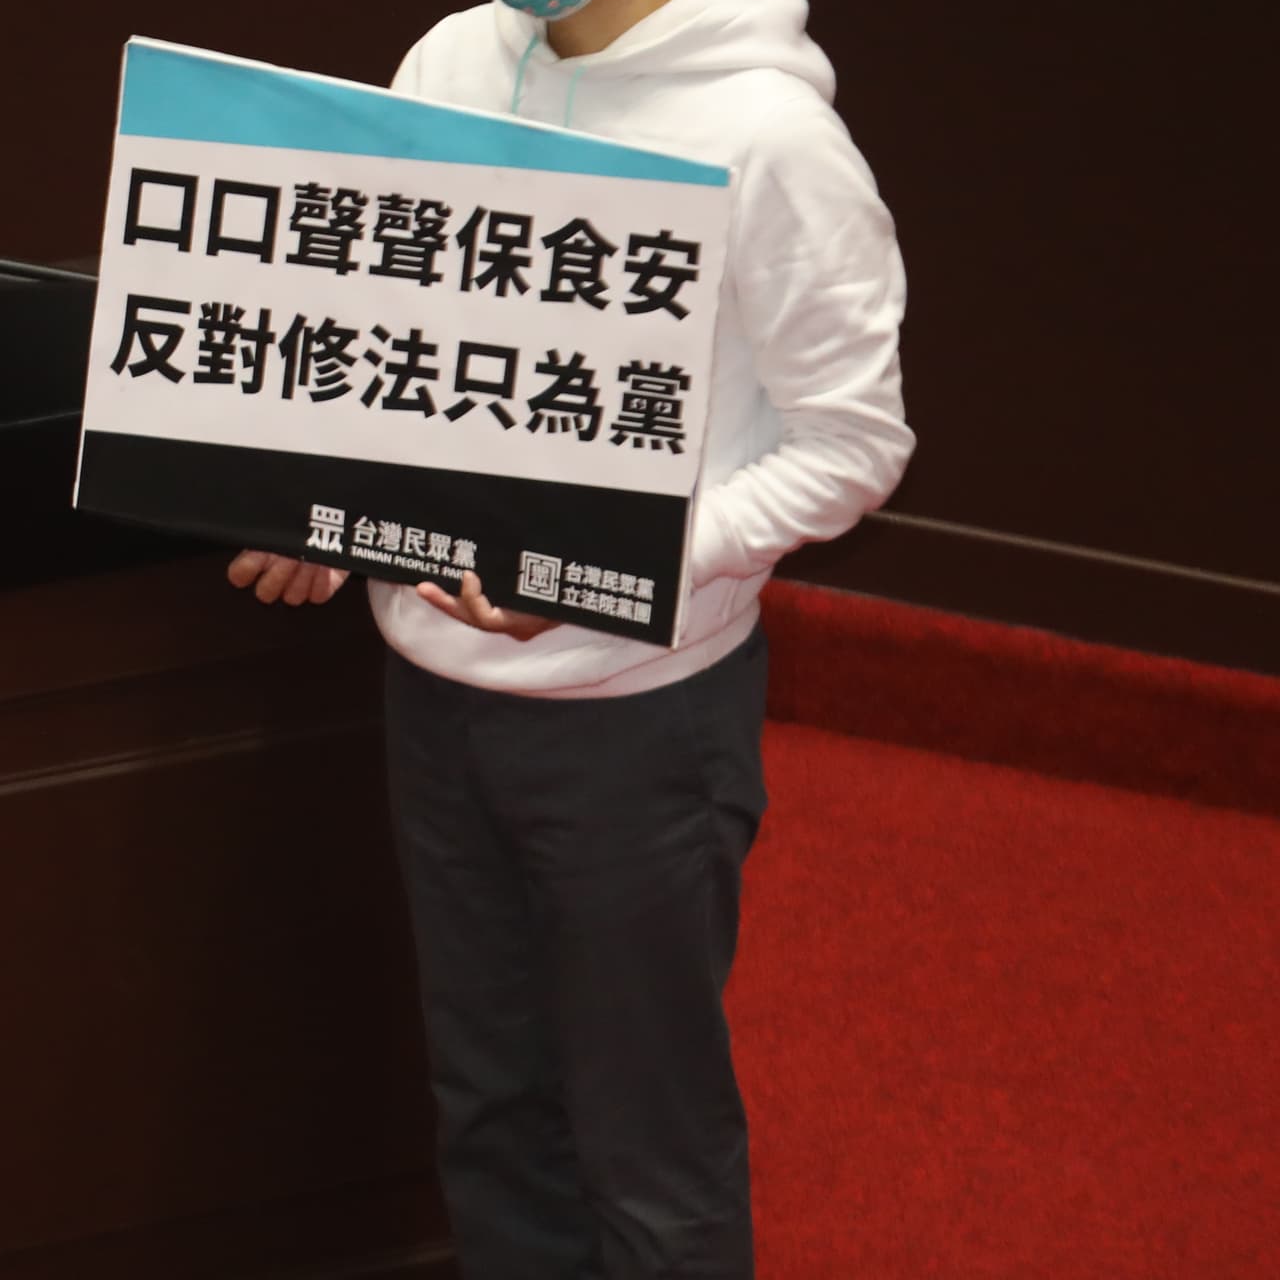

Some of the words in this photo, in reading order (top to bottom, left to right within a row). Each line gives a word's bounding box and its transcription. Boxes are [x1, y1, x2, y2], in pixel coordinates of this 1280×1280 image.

[122, 167, 702, 321] 口口聲聲保食安
[110, 293, 693, 456] 反對修法只為黨
[350, 545, 393, 564] TAIWAN
